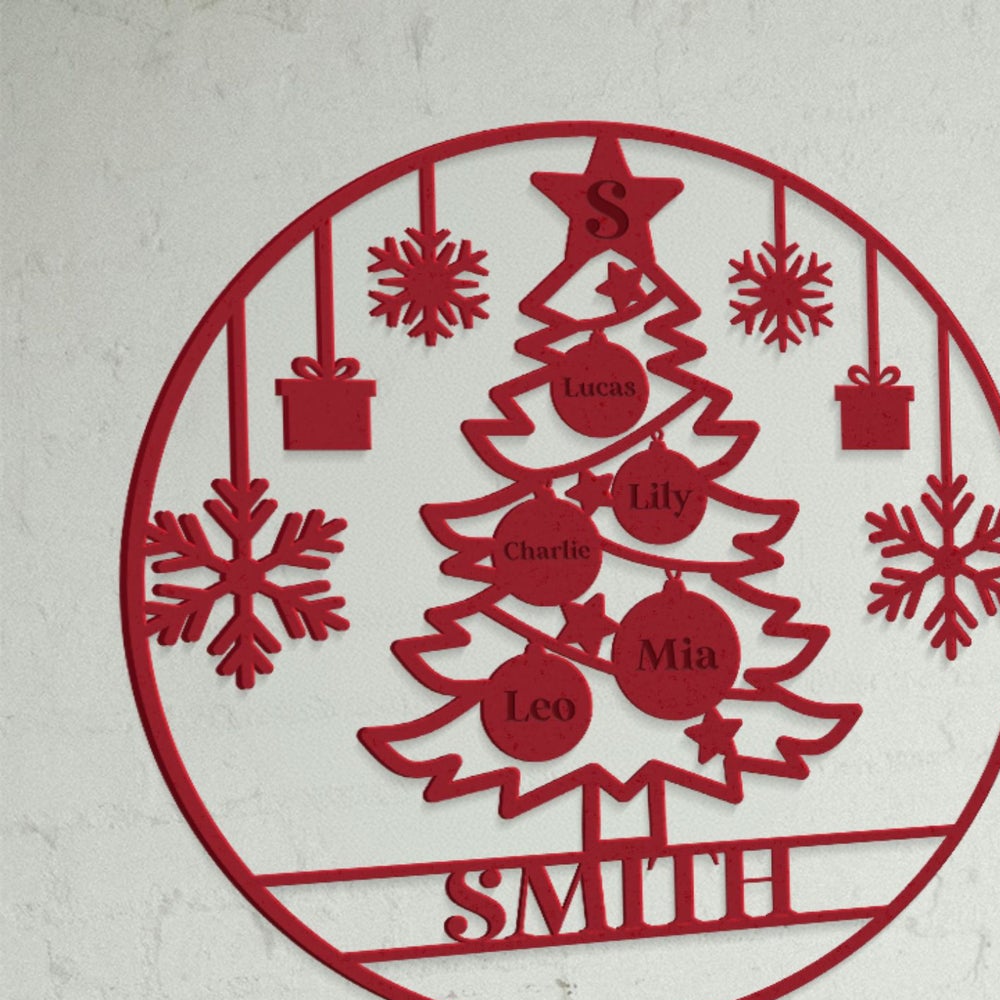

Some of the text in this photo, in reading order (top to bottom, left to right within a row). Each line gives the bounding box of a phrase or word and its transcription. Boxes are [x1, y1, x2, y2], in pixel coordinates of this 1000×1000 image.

[585, 179, 629, 240] S
[563, 377, 636, 398] Lucas
[628, 481, 693, 519] Lily
[503, 540, 591, 561] Charlie
[635, 637, 719, 671] Mia
[504, 690, 576, 722] Leo
[444, 848, 792, 943] SMITH
